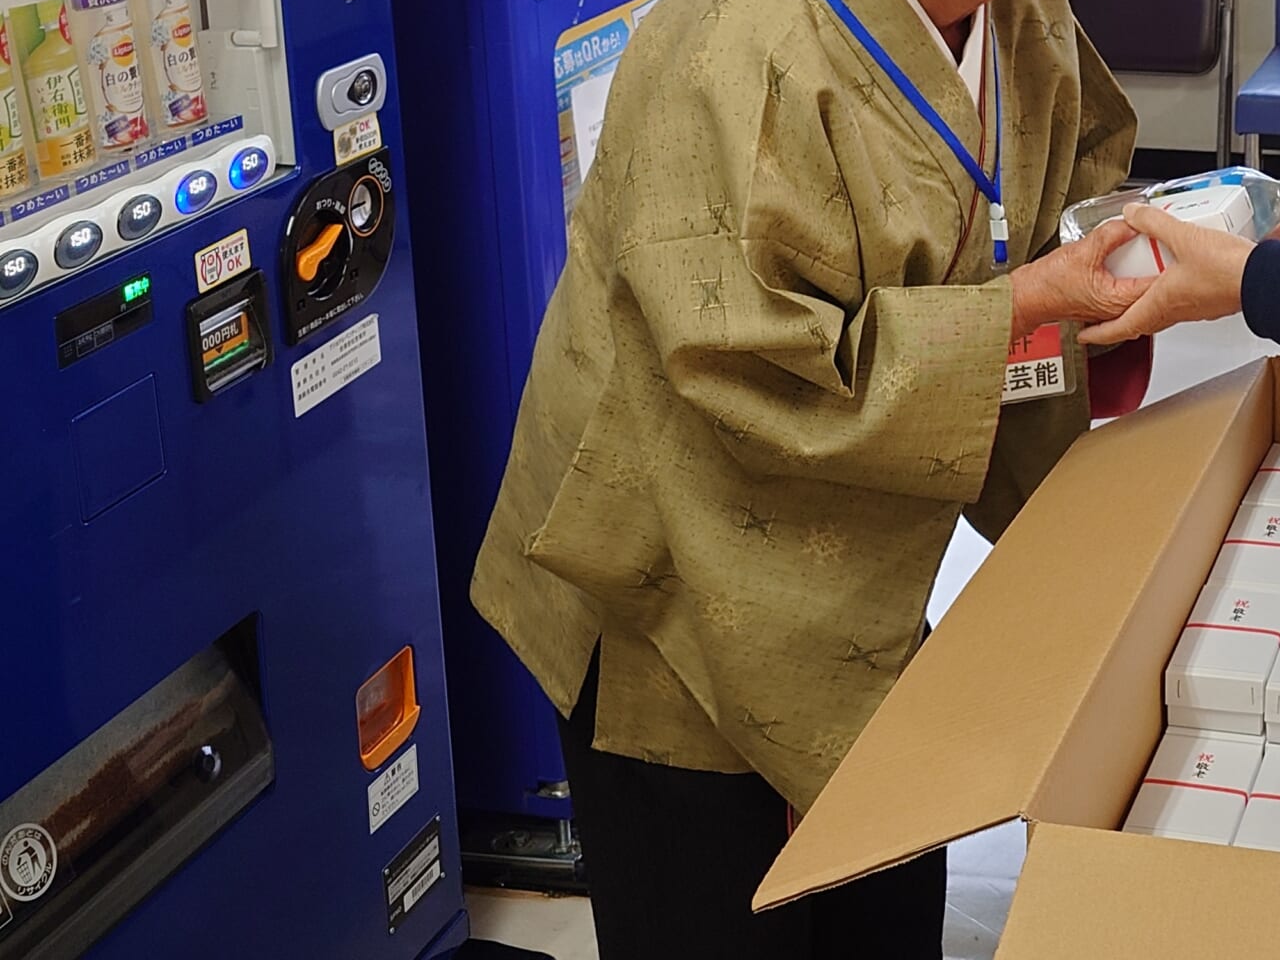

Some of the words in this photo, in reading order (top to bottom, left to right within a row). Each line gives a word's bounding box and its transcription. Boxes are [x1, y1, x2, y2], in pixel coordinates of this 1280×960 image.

[46, 75, 72, 131] 伊右衛門
[196, 118, 239, 139] つめた〜い
[140, 140, 182, 164] つめた〜い
[242, 152, 259, 171] 150
[80, 162, 126, 188] つめた〜い
[188, 176, 206, 195] 150
[16, 189, 66, 215] つめた〜い
[133, 201, 151, 220] 150
[70, 227, 91, 247] 150
[4, 256, 25, 277] 150
[226, 257, 243, 272] OK
[1002, 361, 1059, 392] 芸能
[1265, 517, 1280, 537] 祝敬老
[1230, 600, 1249, 621] 祝敬老
[1193, 752, 1214, 778] 祝敬老
[17, 862, 53, 896] リサイクル
